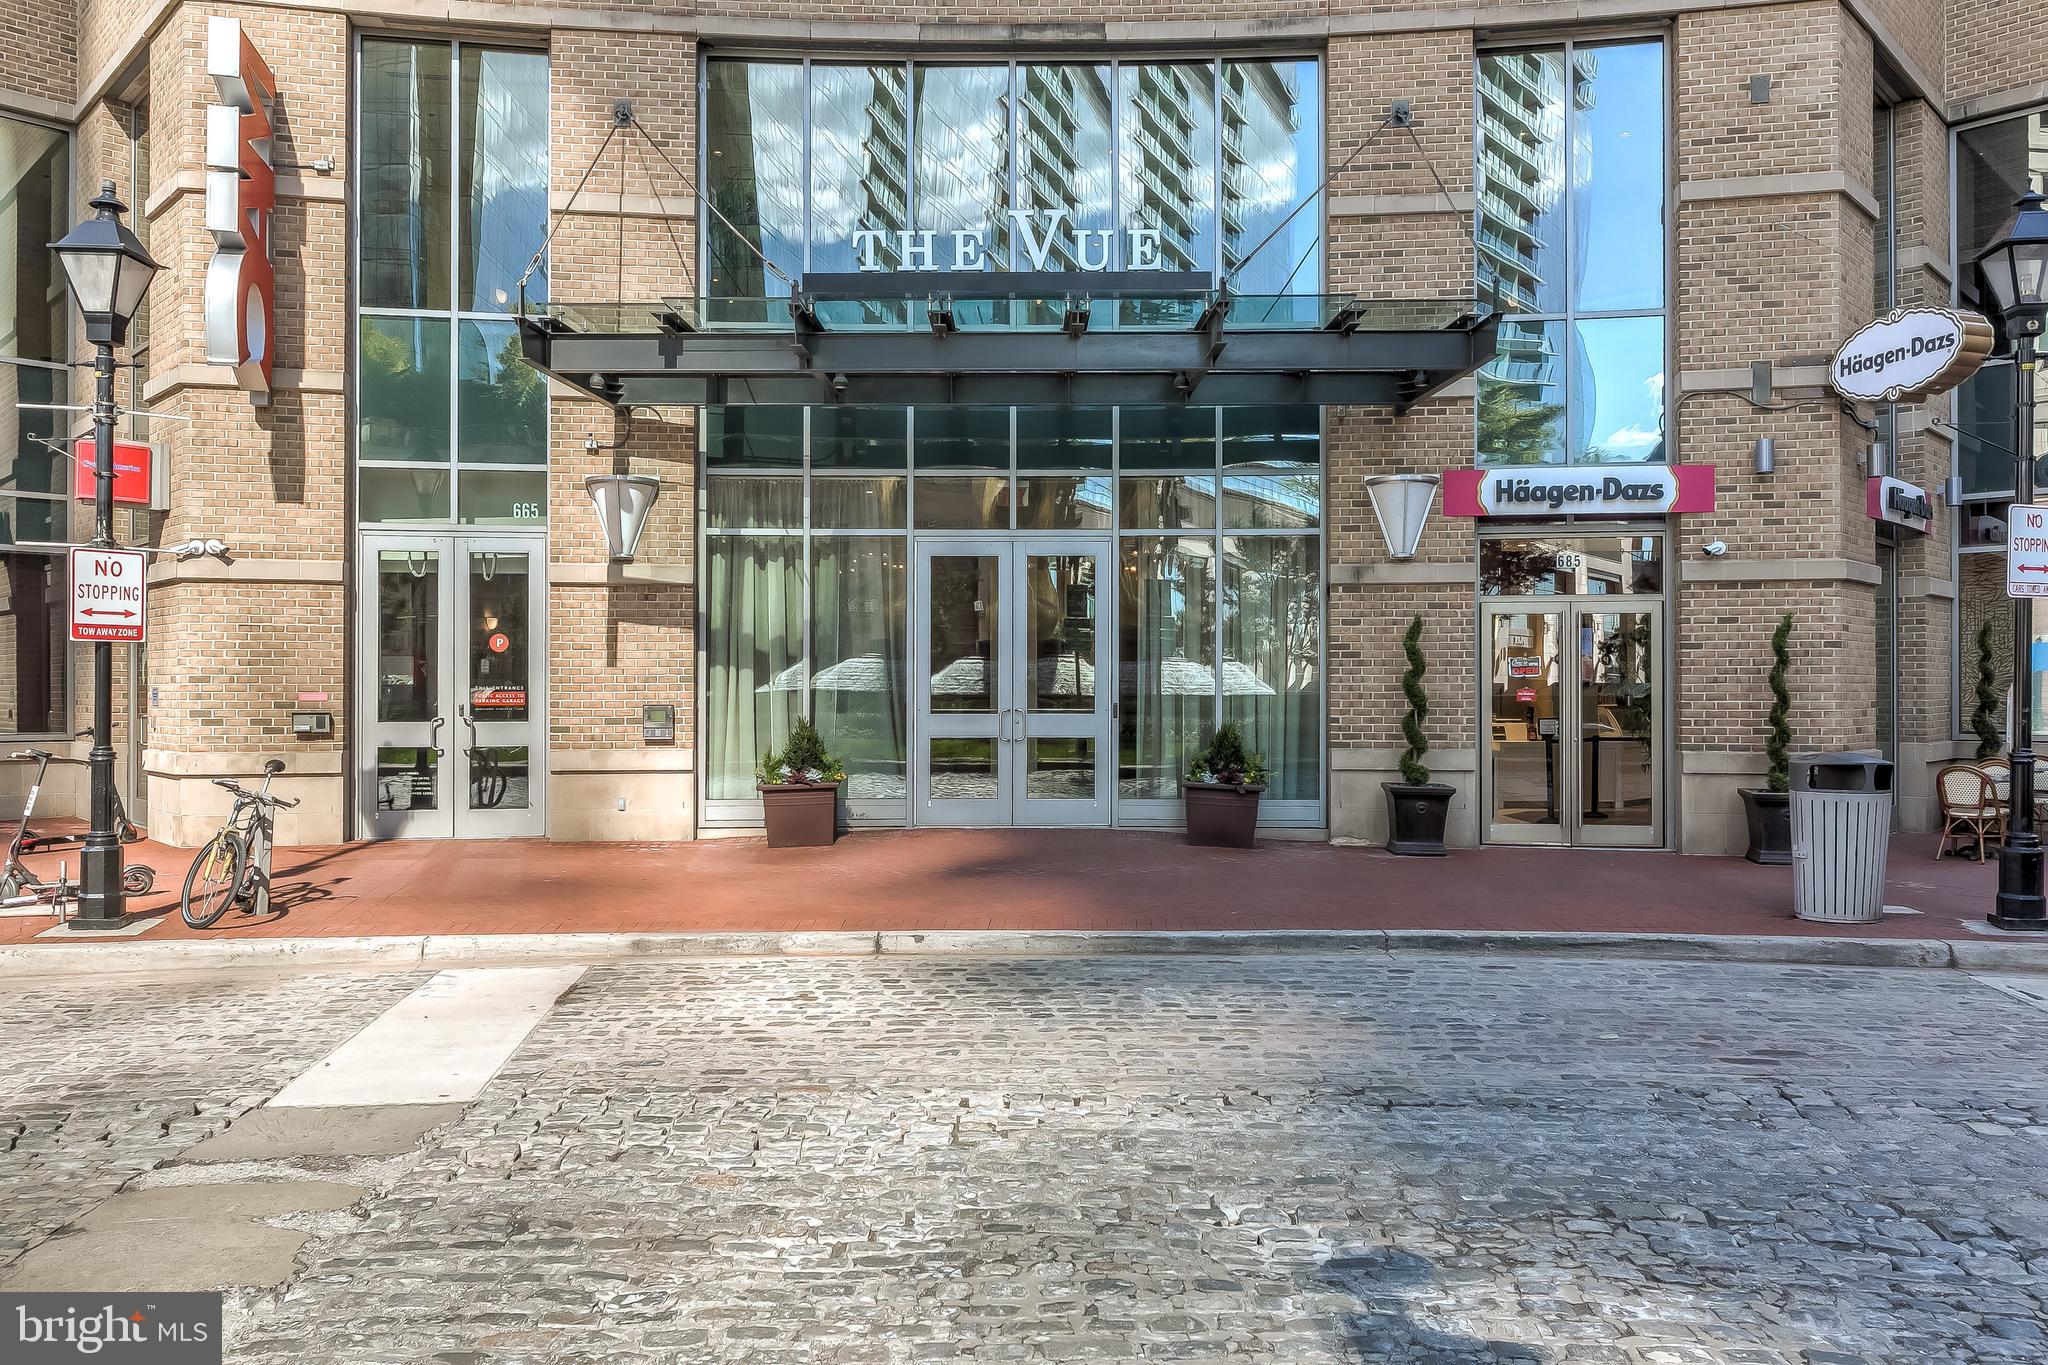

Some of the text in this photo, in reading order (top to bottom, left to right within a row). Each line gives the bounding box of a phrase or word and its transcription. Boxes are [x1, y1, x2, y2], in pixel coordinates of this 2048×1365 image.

[852, 209, 1163, 272] THE VUE
[1840, 332, 1955, 378] Häagen-Dazs
[1495, 477, 1665, 509] Häagen-Dazs
[513, 502, 539, 519] 665
[2027, 513, 2043, 528] NO
[95, 559, 123, 577] NO
[1557, 555, 1581, 568] 685
[77, 583, 139, 601] STOPPING
[78, 626, 138, 637] TOW AWAY ZONE
[496, 638, 504, 648] P
[1512, 666, 1539, 674] OPEN
